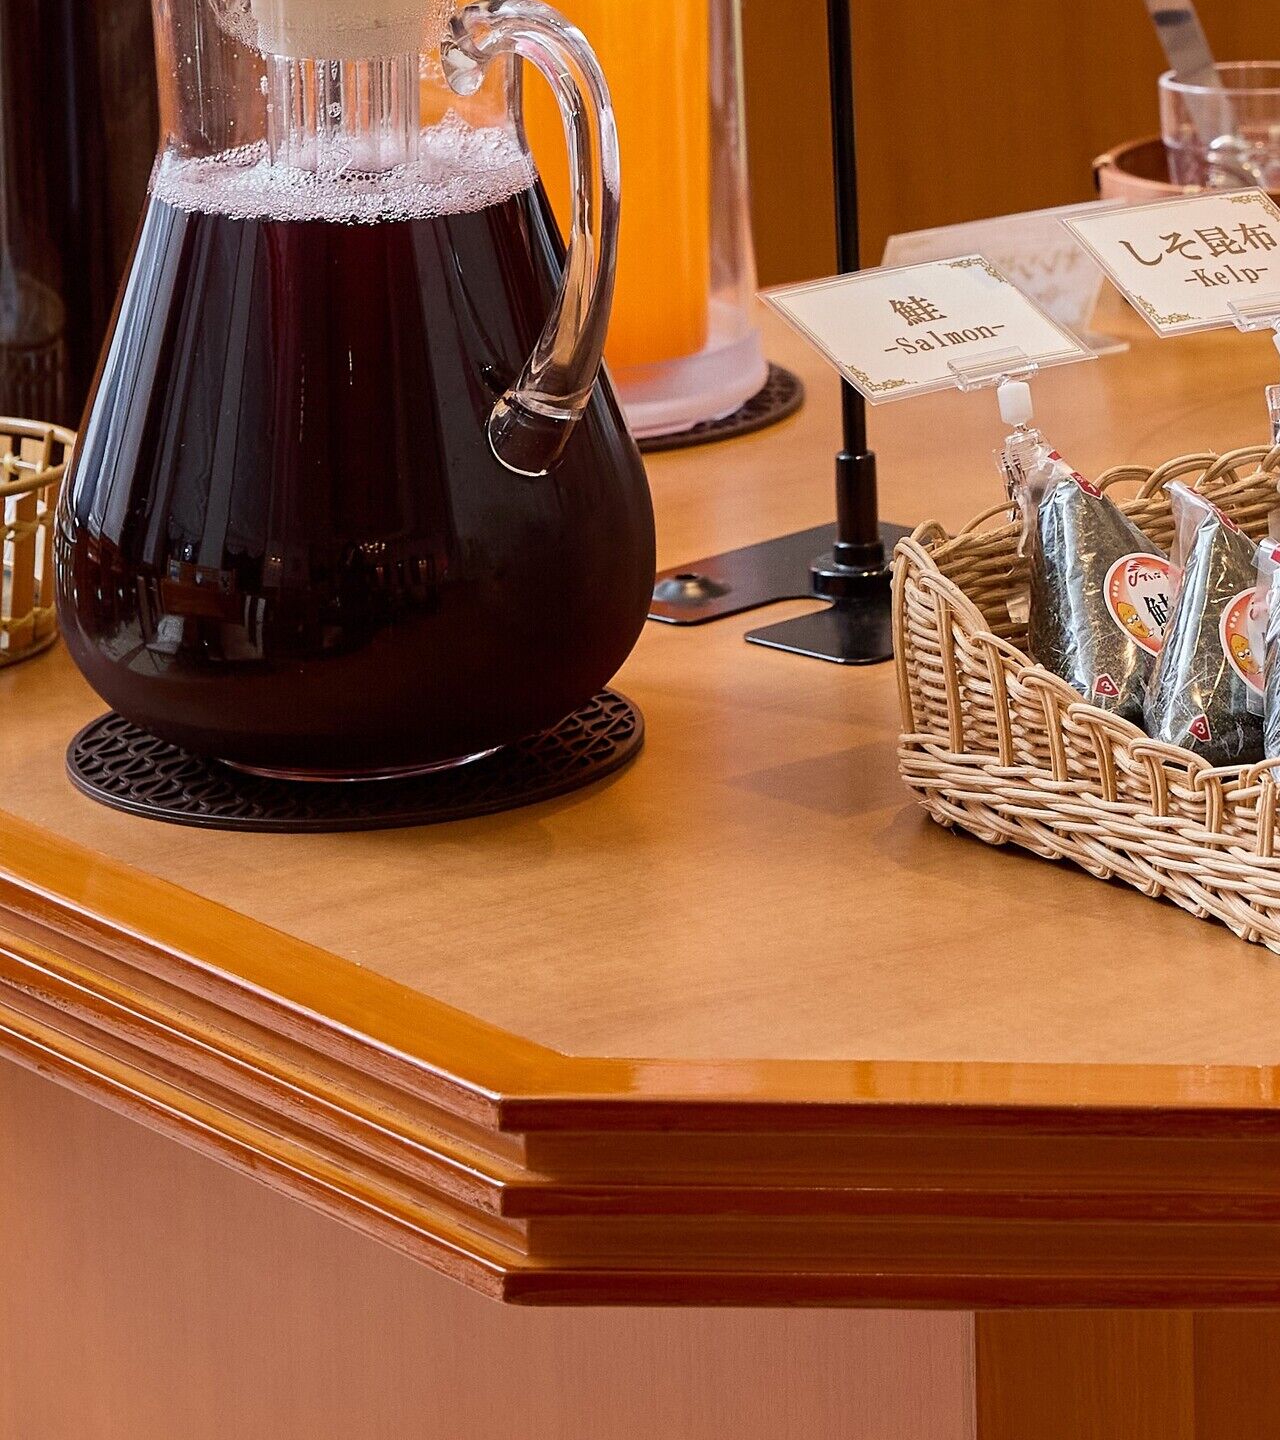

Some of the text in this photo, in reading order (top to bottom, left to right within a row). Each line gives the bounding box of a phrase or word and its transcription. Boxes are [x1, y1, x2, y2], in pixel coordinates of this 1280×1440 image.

[1117, 221, 1278, 267] しそ昆布
[1183, 263, 1270, 289] -Kelp-
[887, 294, 948, 327] 鮭
[883, 323, 1006, 356] -Salmon-
[1100, 679, 1114, 693] 3
[1196, 720, 1207, 735] 3
